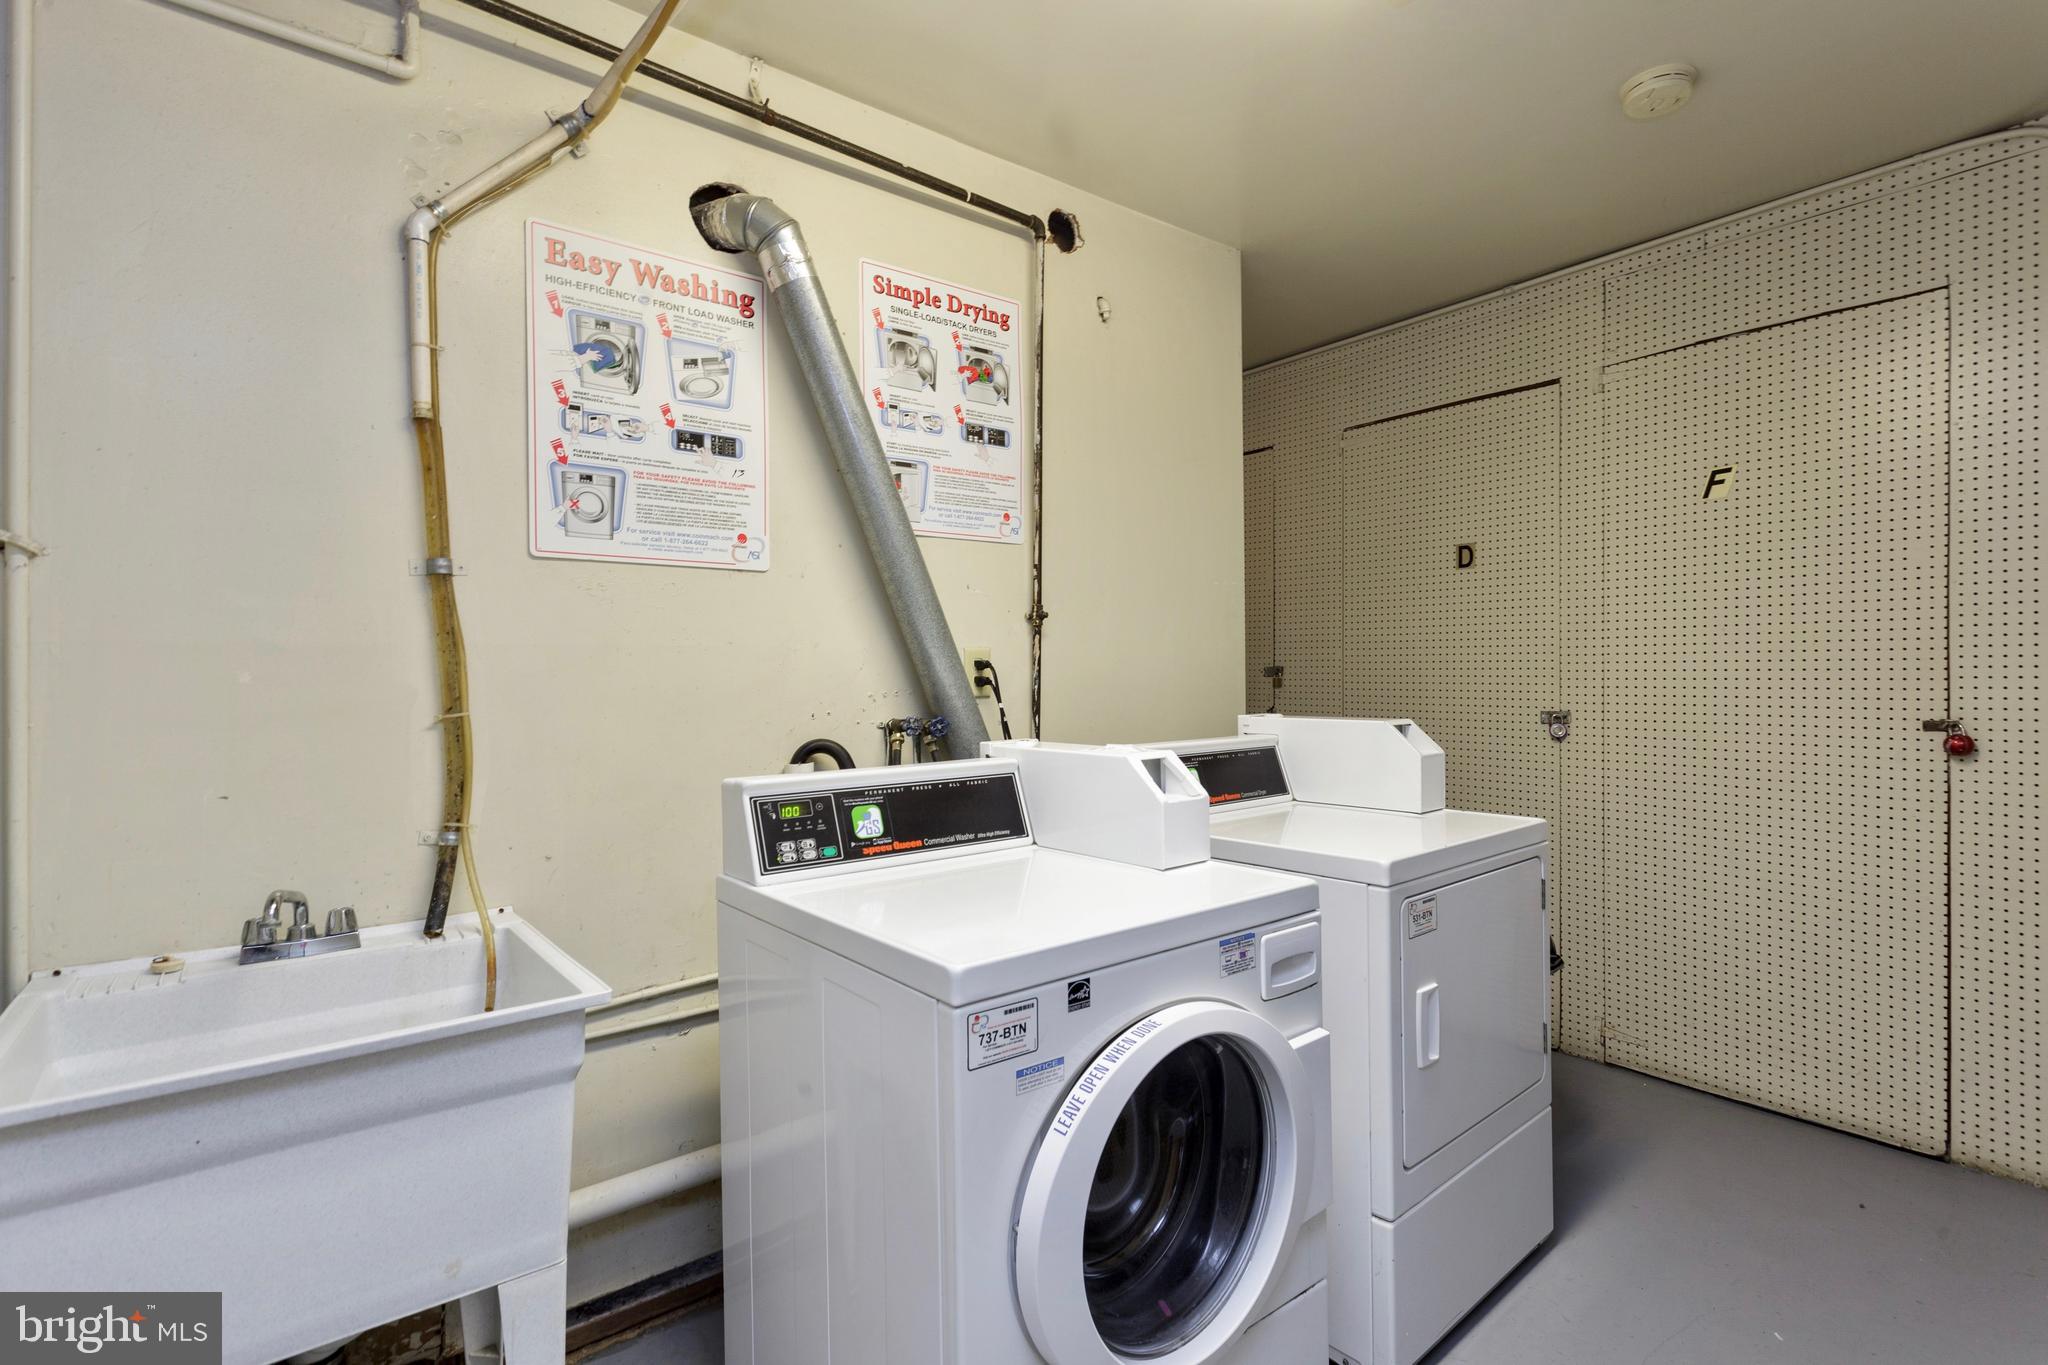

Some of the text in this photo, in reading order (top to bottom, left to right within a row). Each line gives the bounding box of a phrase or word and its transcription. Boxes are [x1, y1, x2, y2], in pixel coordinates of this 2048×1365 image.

[544, 236, 621, 286] Easy
[629, 257, 755, 319] Washing
[544, 273, 637, 303] HIGH-EFFICIENCY
[652, 299, 685, 314] FRONT
[688, 306, 715, 321] LOAD
[717, 313, 755, 330] WASHER
[872, 274, 1011, 332] Simple Drying
[969, 325, 997, 339] DRYERS
[1702, 467, 1733, 499] F
[1458, 545, 1474, 568] D
[864, 788, 904, 796] PERMANENT
[781, 806, 800, 818] 100
[893, 840, 923, 850] Queen
[924, 834, 955, 846] Commercial
[956, 832, 976, 842] Washer
[979, 1022, 1027, 1046] 737-BTN
[1023, 1060, 1058, 1076] NOTICE
[1053, 1019, 1162, 1136] LEAVE OPEN WHEN DONE
